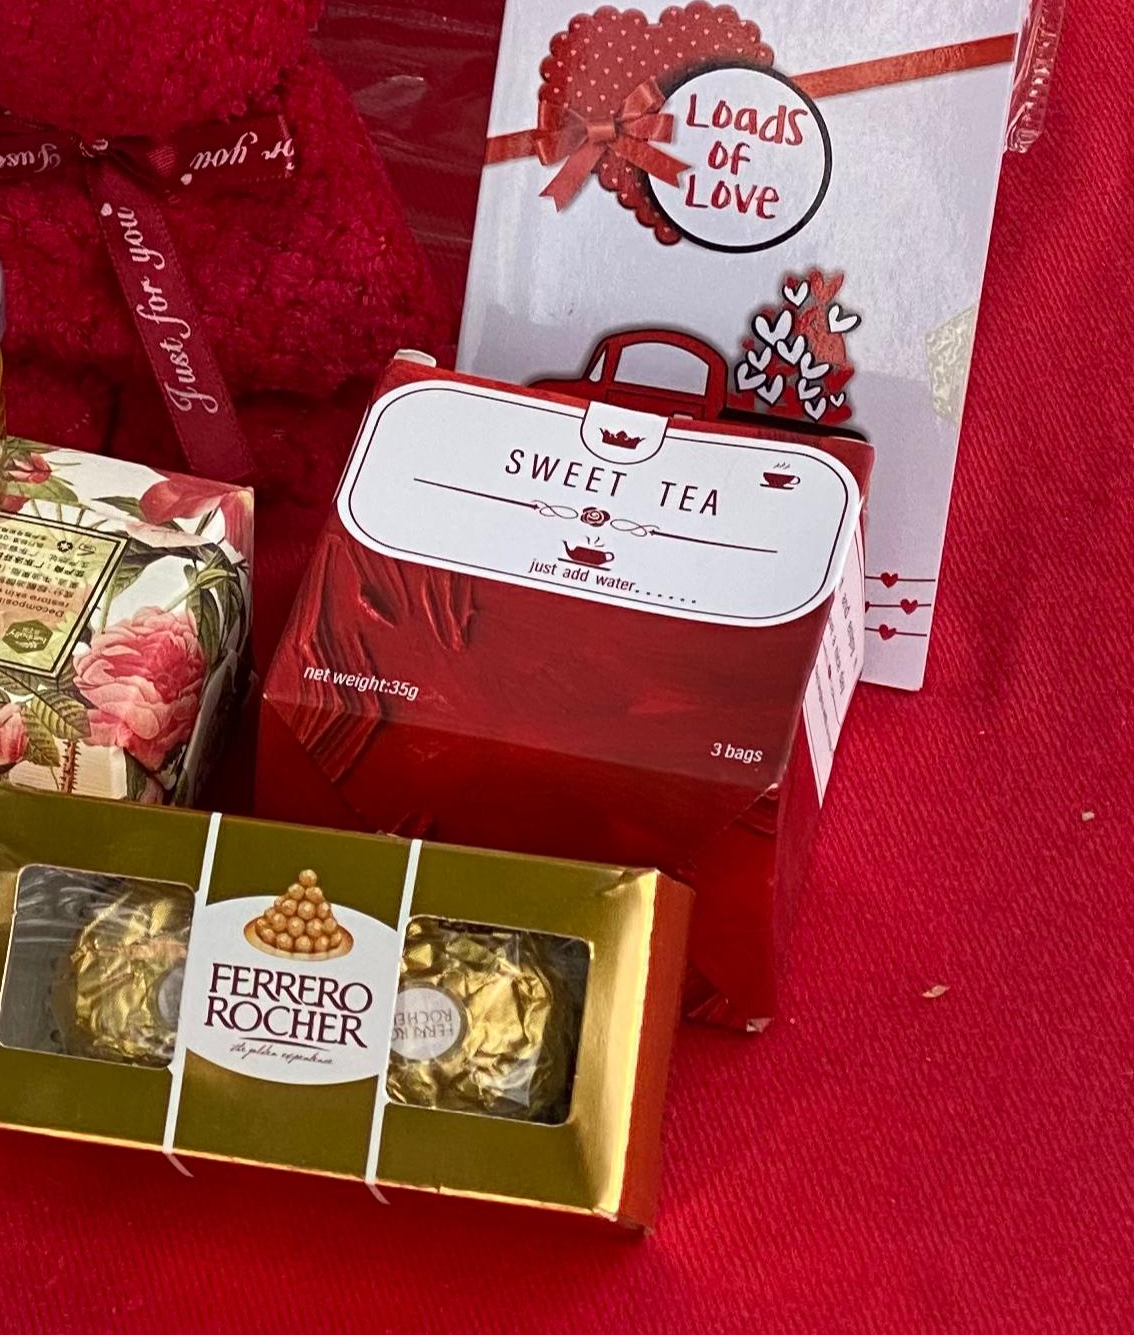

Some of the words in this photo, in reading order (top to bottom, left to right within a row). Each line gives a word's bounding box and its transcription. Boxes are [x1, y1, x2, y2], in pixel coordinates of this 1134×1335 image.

[686, 93, 808, 146] Loads
[190, 132, 258, 170] you
[708, 141, 751, 175] of
[685, 174, 780, 220] Love
[117, 207, 165, 270] you
[136, 275, 191, 339] for
[160, 336, 219, 414] Just
[505, 449, 627, 497] SWEET
[660, 481, 718, 516] TEA
[528, 558, 558, 574] just
[562, 568, 589, 582] add
[2, 588, 28, 600] skin
[27, 593, 70, 608] restore
[303, 666, 331, 683] net
[333, 671, 419, 701] weight:35g
[710, 742, 723, 757] 3
[724, 743, 763, 764] bags
[209, 962, 373, 1014] FERRERO
[204, 996, 368, 1049] ROCHER
